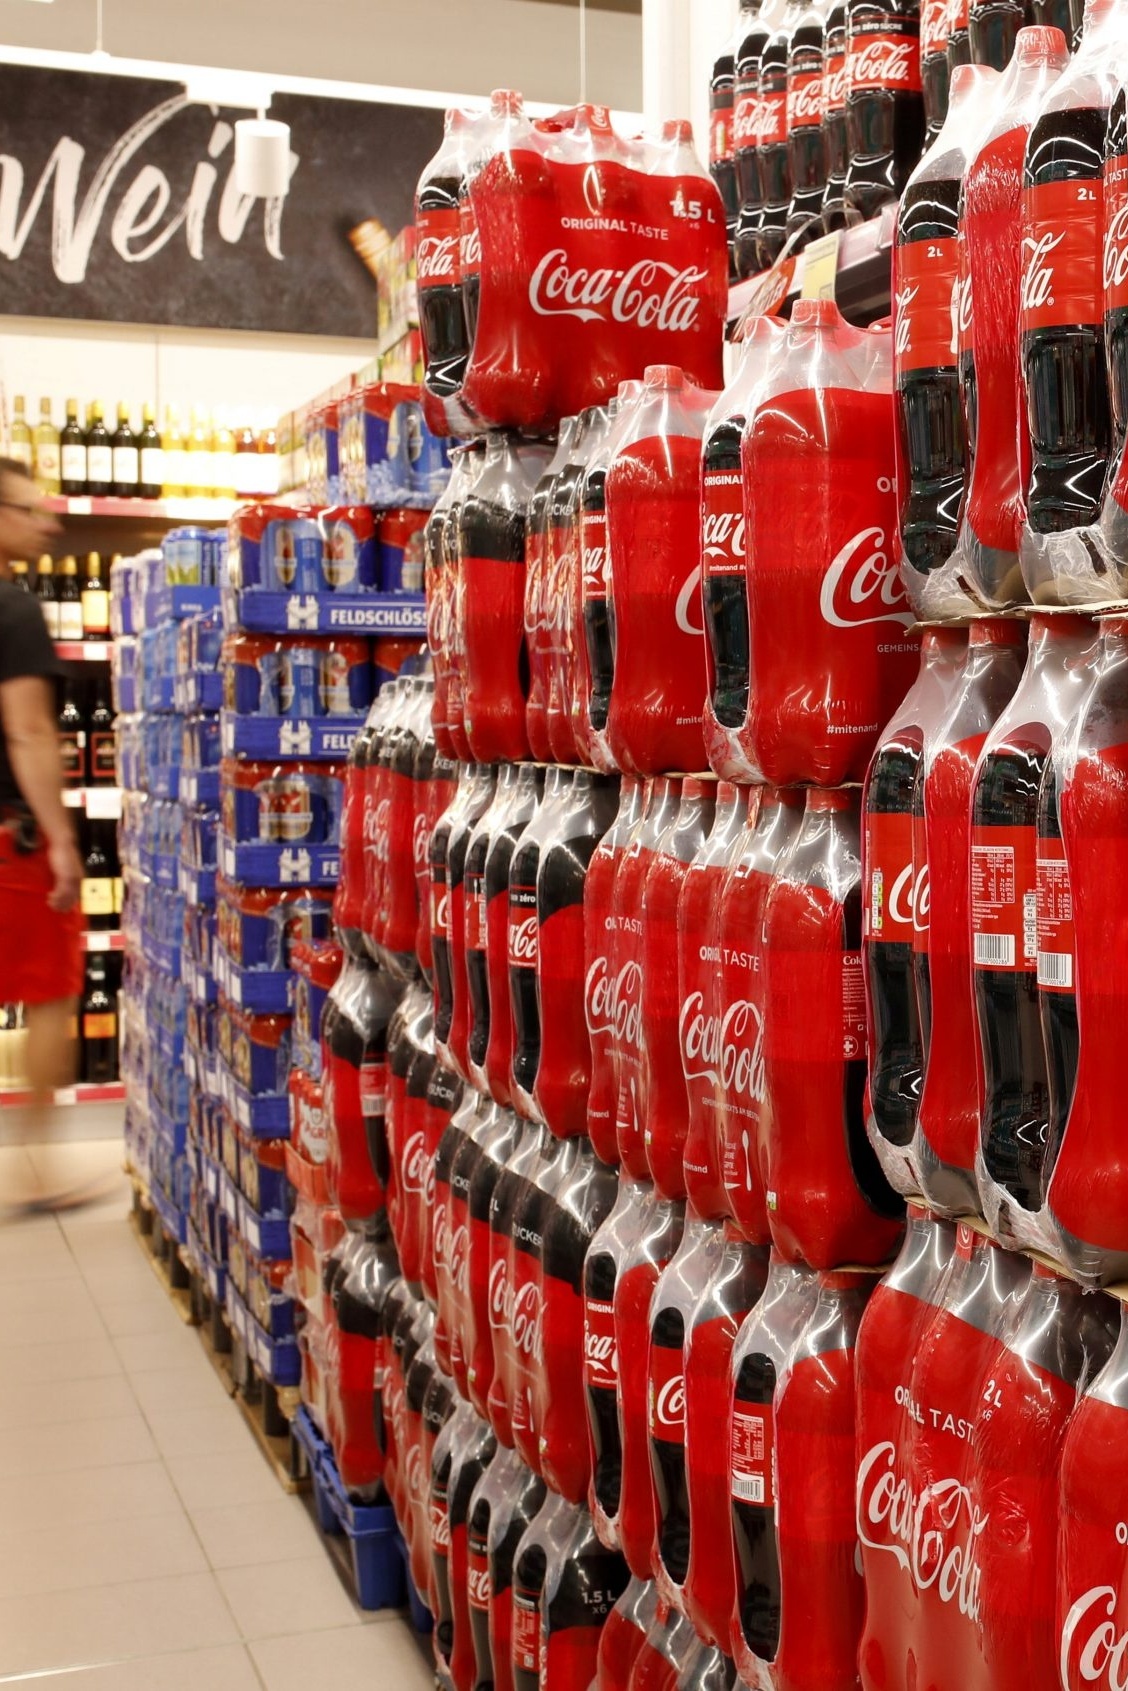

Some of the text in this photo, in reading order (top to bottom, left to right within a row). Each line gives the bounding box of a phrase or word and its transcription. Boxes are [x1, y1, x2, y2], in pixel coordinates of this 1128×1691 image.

[561, 216, 669, 241] ORIGINAL TASTE
[529, 249, 709, 332] Coca-Cola
[826, 722, 879, 735] #mitenand
[723, 949, 760, 972] TASTE
[856, 1441, 990, 1623] Coca-Cola
